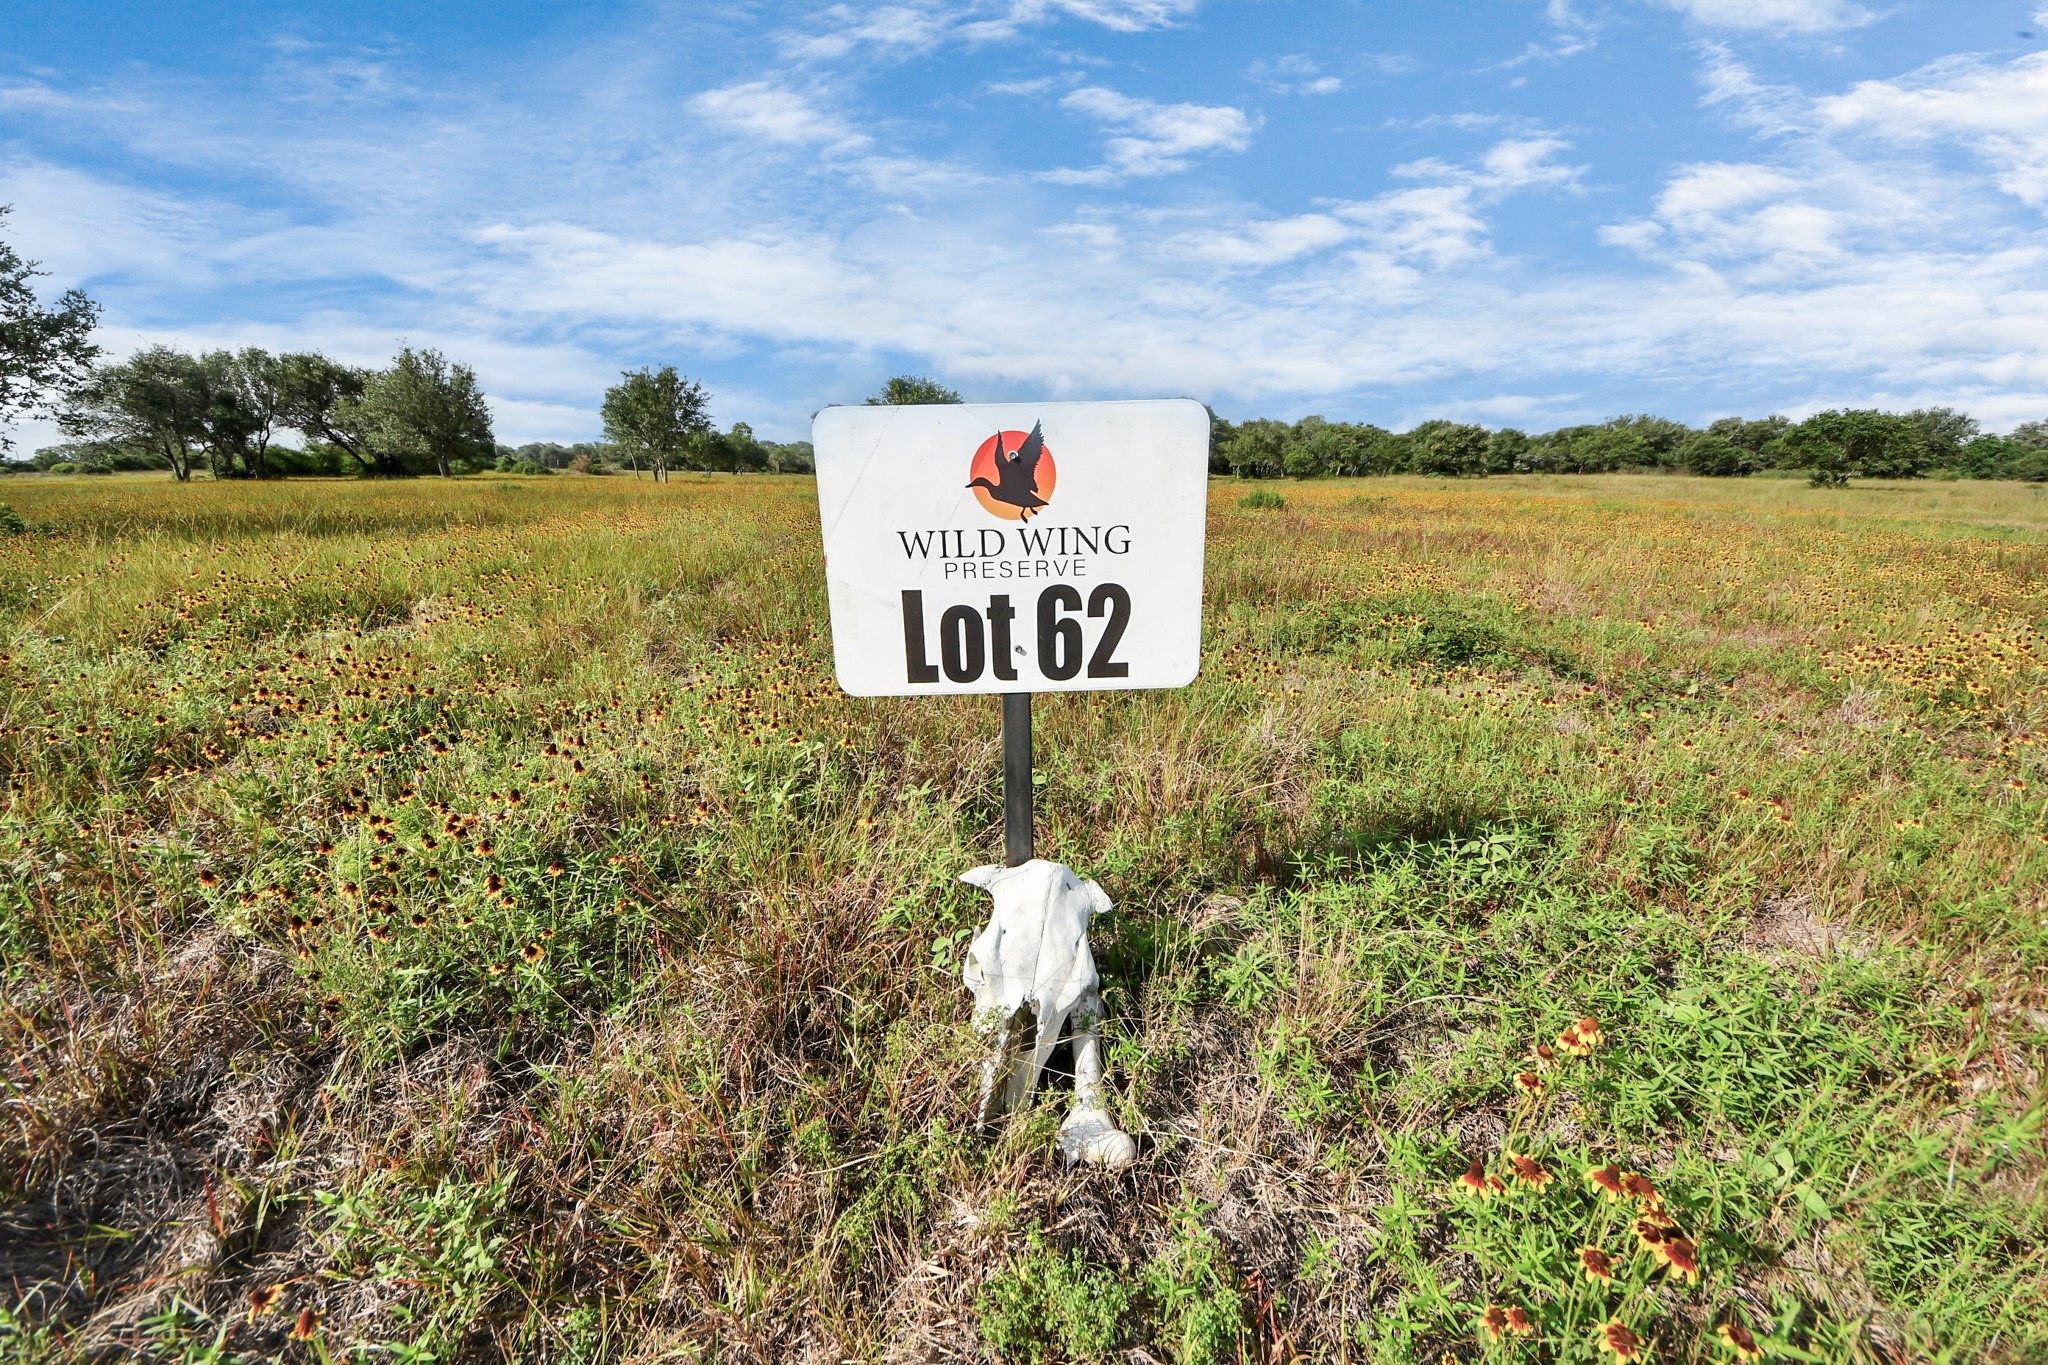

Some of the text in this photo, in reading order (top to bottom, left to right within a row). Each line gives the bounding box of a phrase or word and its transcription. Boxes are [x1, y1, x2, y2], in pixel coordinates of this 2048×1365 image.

[896, 525, 1132, 560] WILD WING
[944, 559, 1087, 580] PRESERVE
[901, 582, 1132, 684] Lot 62
